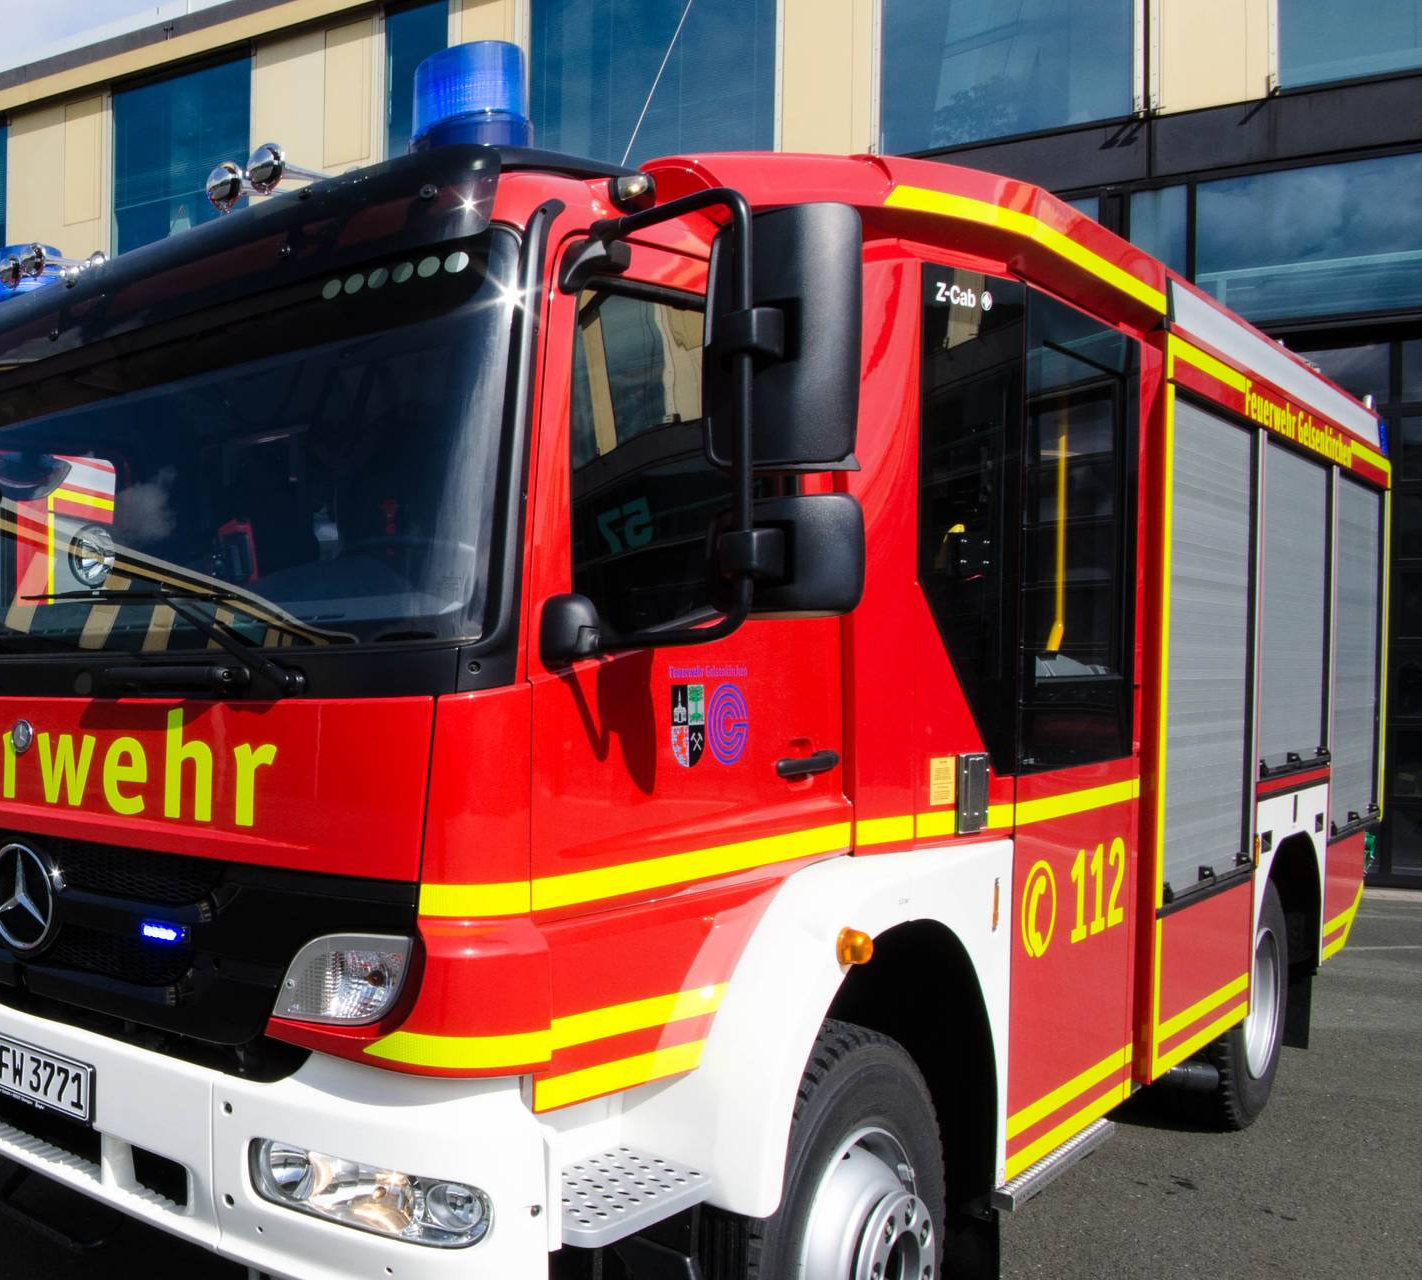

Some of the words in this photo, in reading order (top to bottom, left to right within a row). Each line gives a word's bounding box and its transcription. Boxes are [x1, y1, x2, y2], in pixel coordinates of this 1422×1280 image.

[935, 281, 977, 309] Z-Cab
[1245, 378, 1296, 440] Feuerwehr
[1297, 408, 1352, 469] Gelsenkirchen
[1070, 836, 1126, 945] 112
[29, 1055, 84, 1111] 3771
